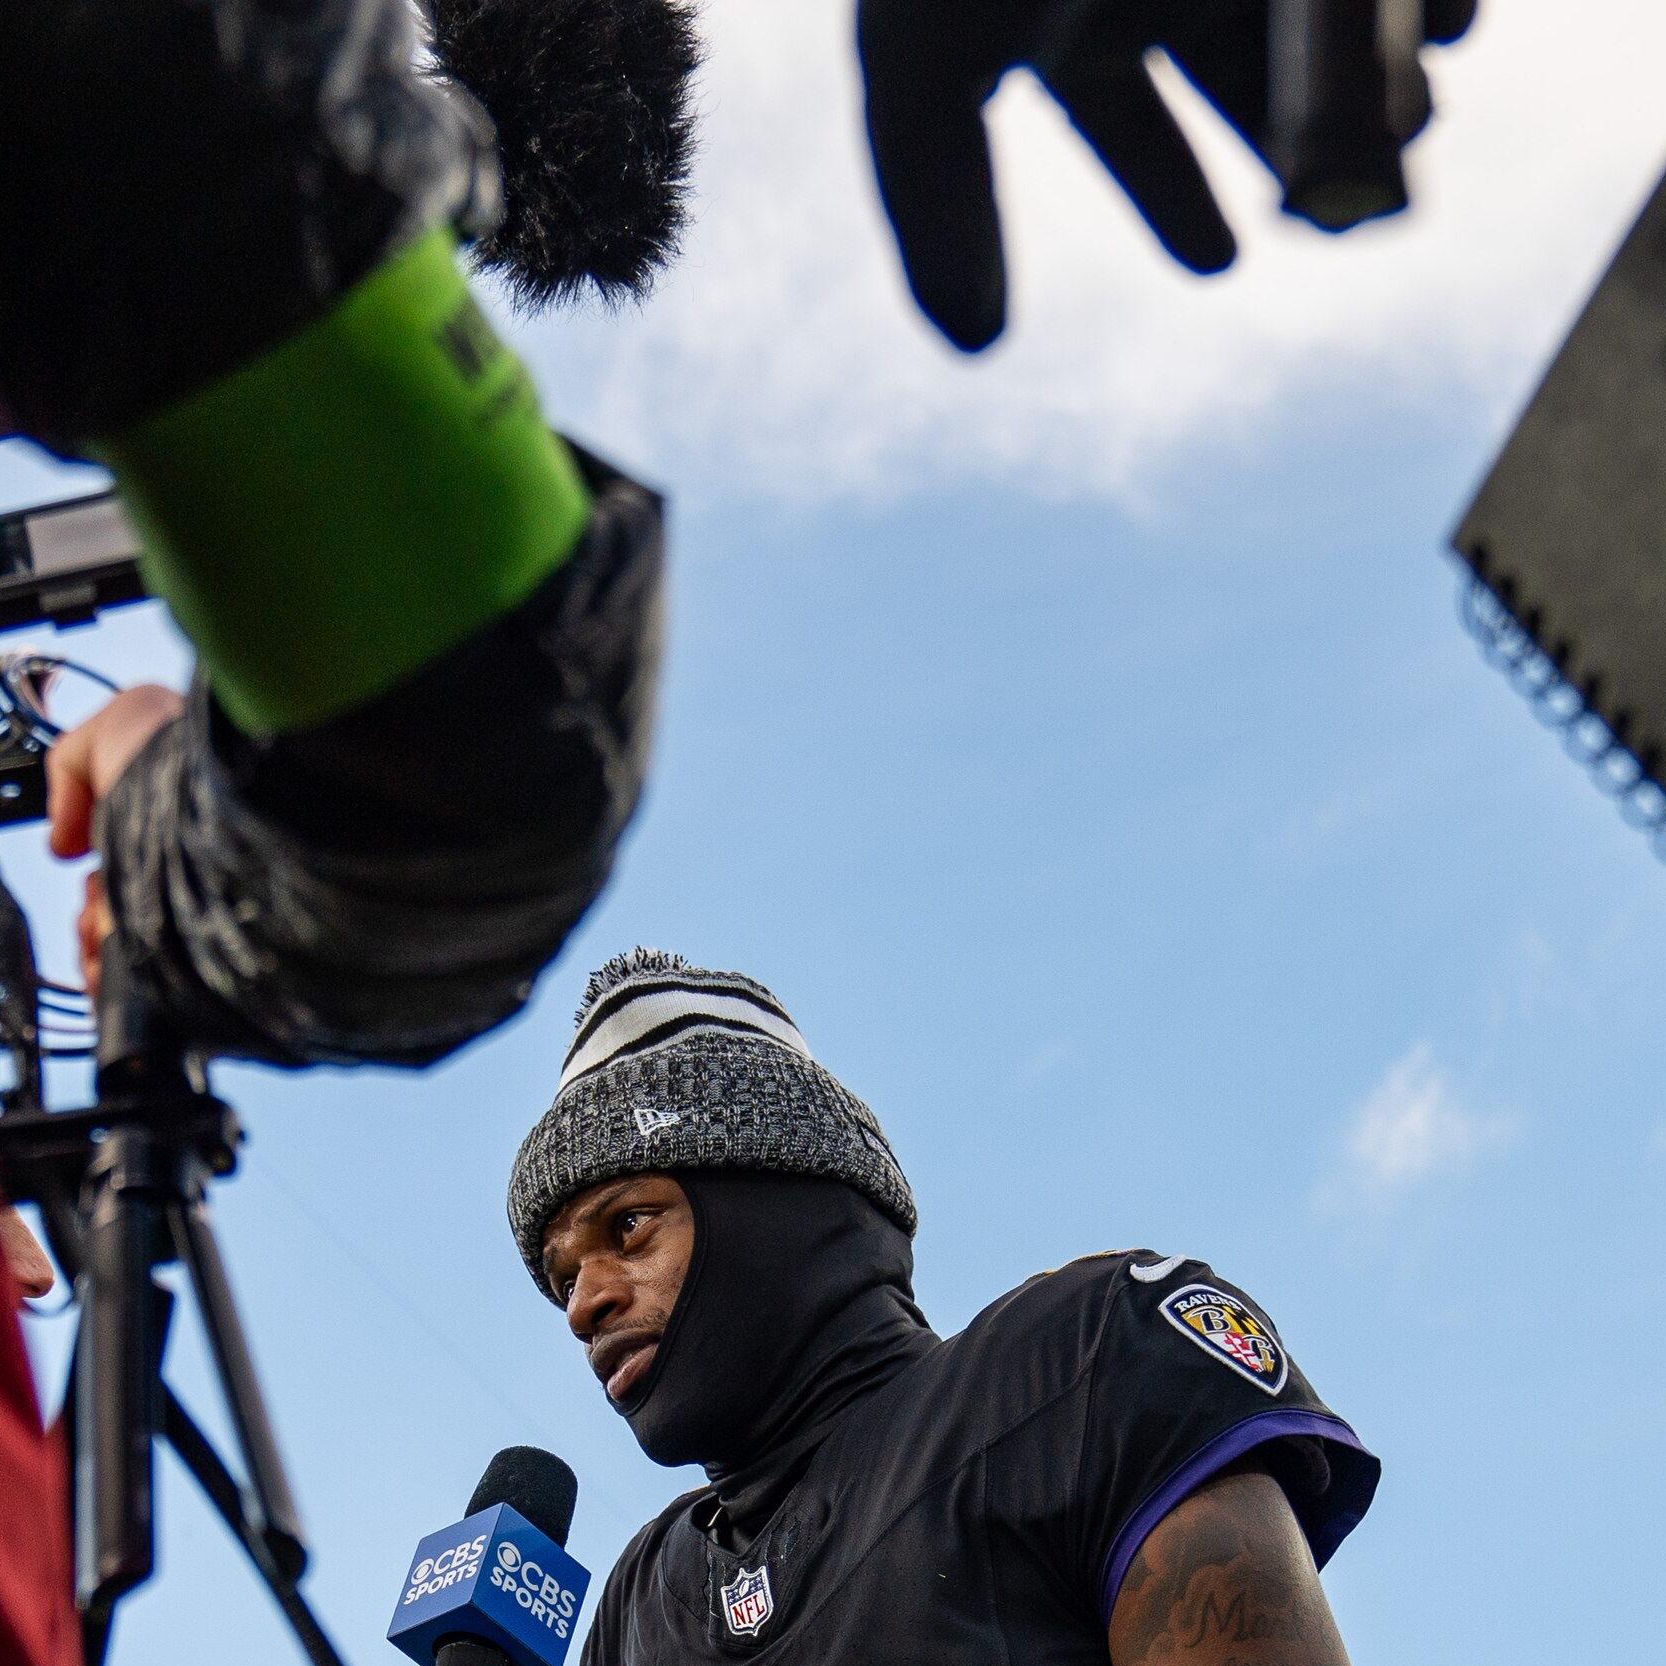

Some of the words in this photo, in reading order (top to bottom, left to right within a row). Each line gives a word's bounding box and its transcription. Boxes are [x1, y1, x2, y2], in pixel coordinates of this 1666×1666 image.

[1174, 1293, 1242, 1313] RAVENS
[434, 1534, 487, 1575] CBS
[403, 1560, 479, 1605] SPORTS
[490, 1566, 570, 1639] SPORTS
[521, 1561, 576, 1618] CBS
[732, 1593, 766, 1627] NFL
